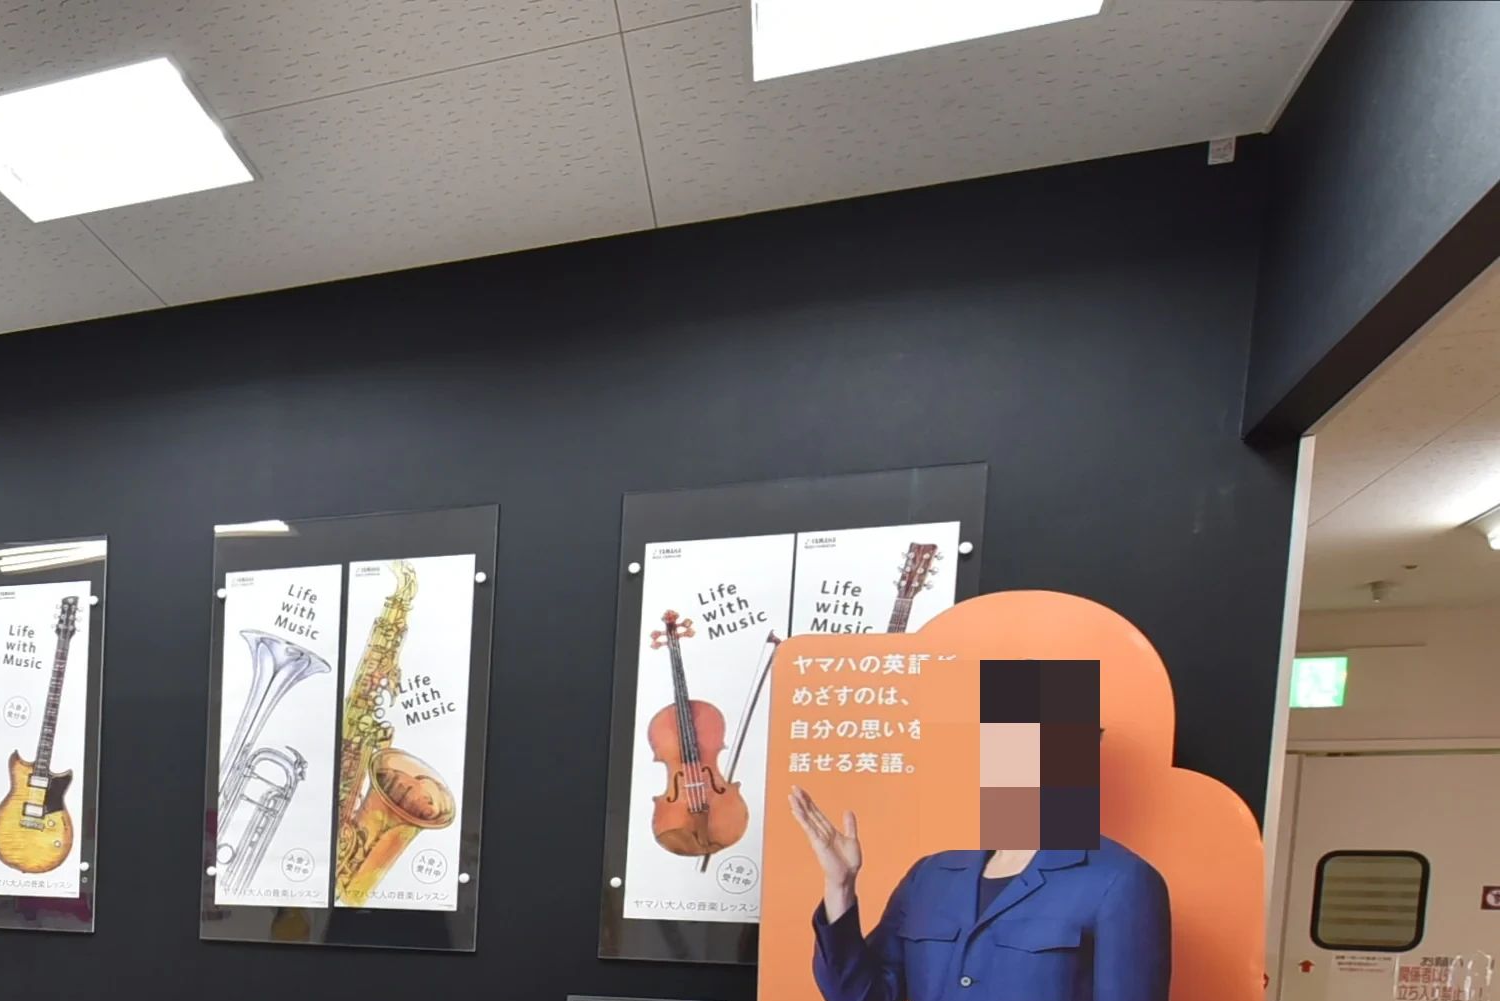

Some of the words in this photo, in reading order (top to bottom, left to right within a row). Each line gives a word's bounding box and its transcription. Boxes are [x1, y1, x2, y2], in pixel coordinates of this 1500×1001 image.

[288, 583, 319, 605] Life
[697, 581, 738, 605] Life
[820, 580, 862, 597] Life
[280, 600, 316, 622] with
[702, 597, 749, 623] with
[814, 599, 864, 616] with
[8, 624, 35, 639] Life
[274, 615, 319, 641] Music
[708, 611, 768, 640] Music
[810, 616, 874, 634] Music
[6, 640, 36, 654] with
[2, 654, 42, 670] Music
[398, 674, 431, 695] Life
[400, 688, 441, 710] with
[792, 687, 910, 706] めざすのは、
[405, 701, 456, 726] Music
[788, 752, 916, 774] 話せる英語。
[721, 873, 752, 887] 受付中
[222, 887, 320, 899] ヤマハ大人の音楽レッスン
[634, 900, 759, 913] ヤマハ大人の音楽レッスン
